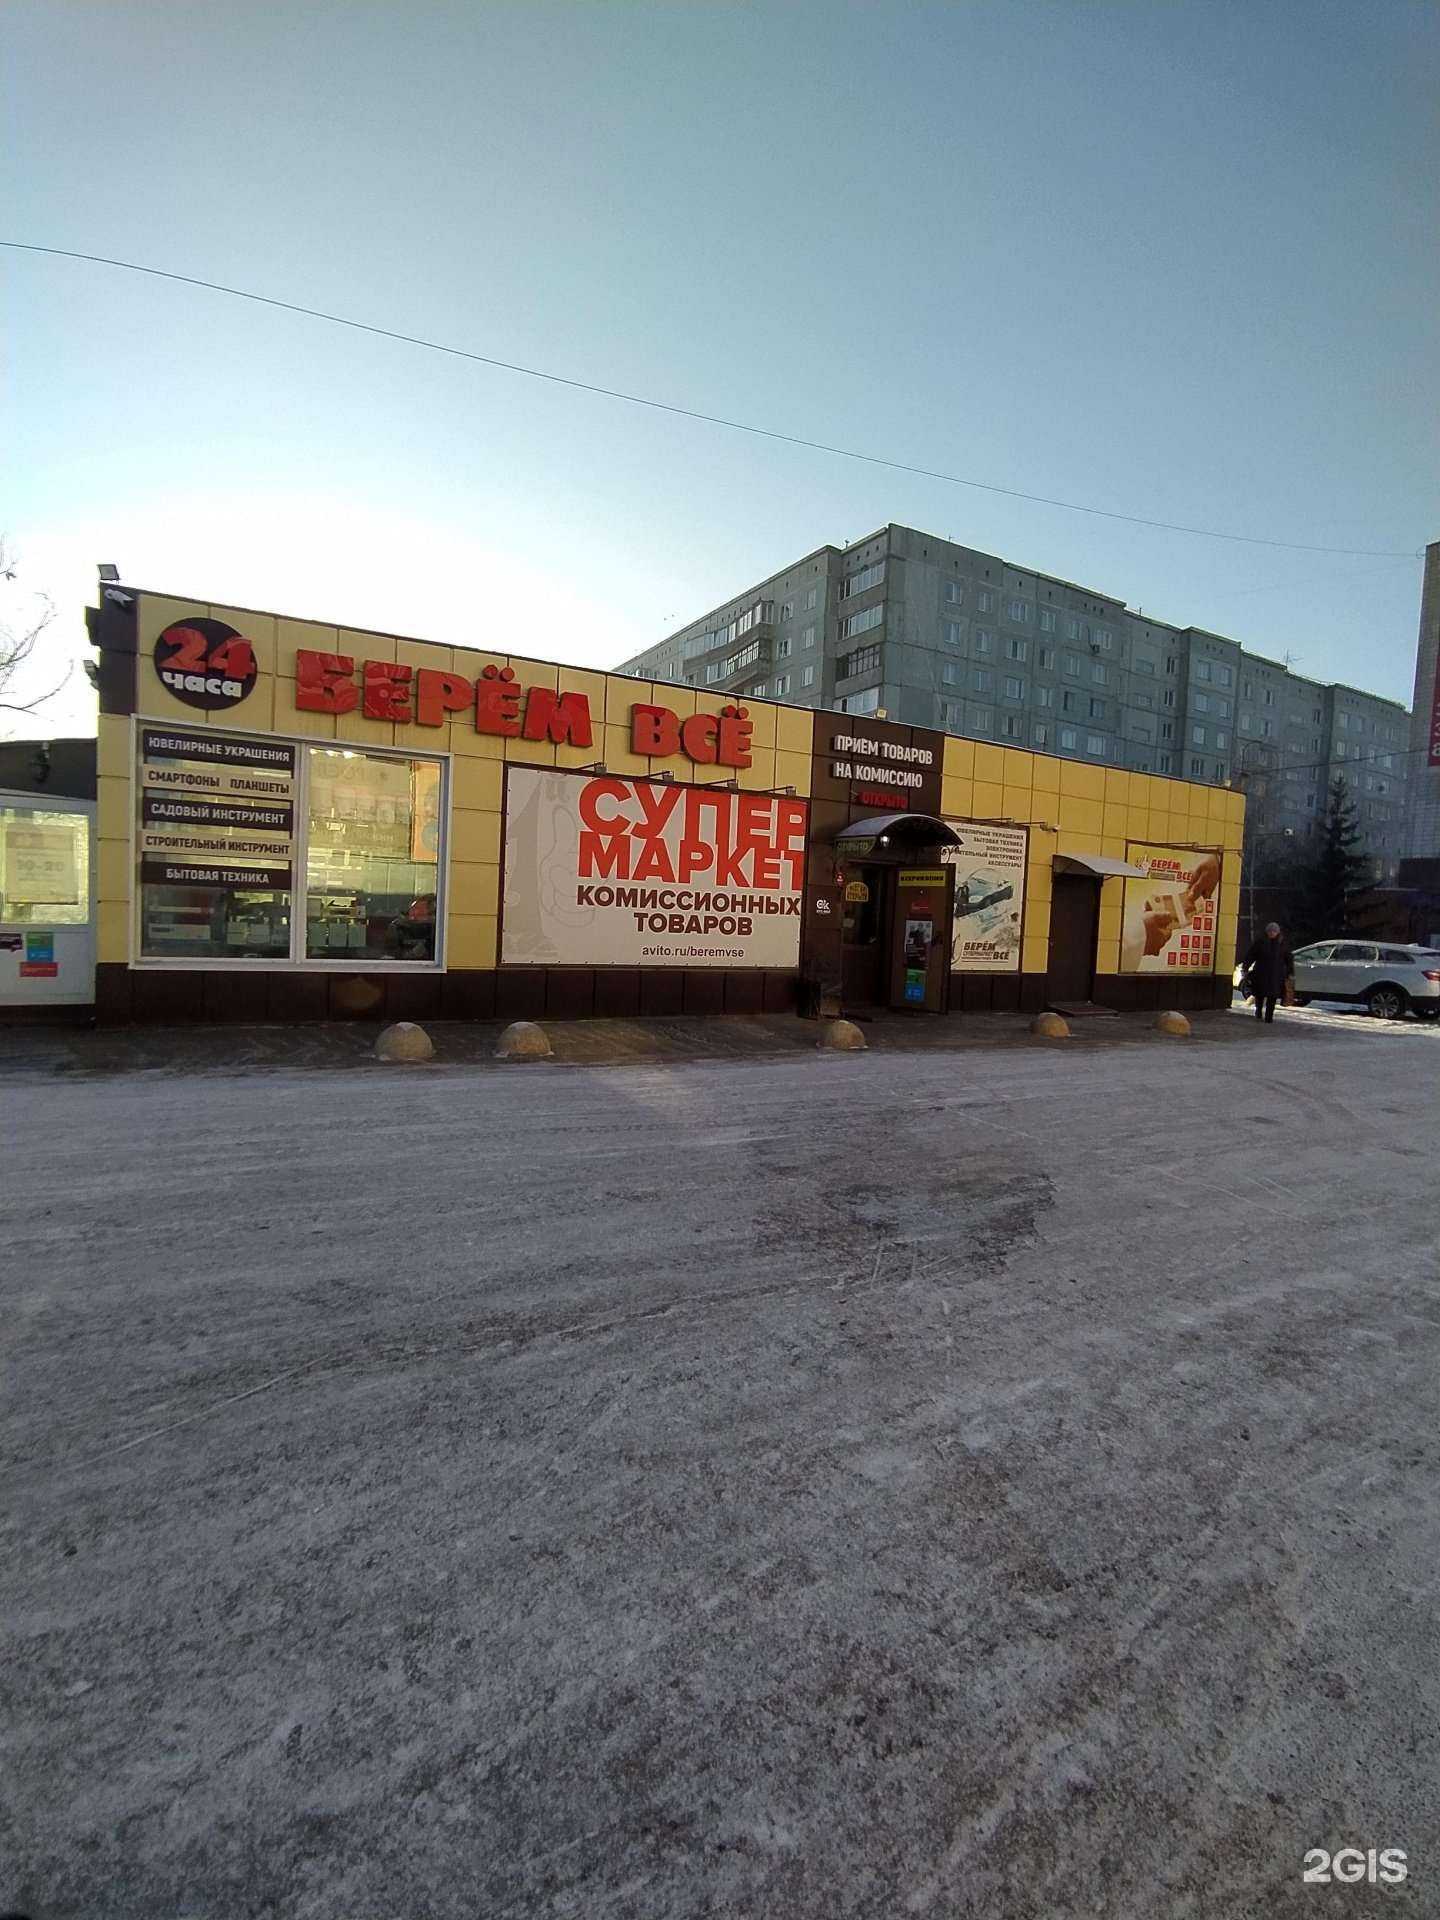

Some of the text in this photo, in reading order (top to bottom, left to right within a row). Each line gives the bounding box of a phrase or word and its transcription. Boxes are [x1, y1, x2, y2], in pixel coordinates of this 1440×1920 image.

[159, 626, 256, 680] 24
[162, 671, 243, 698] часа
[295, 648, 754, 770] БЕРЁМ ВСЁ
[148, 736, 290, 762] ЮВЕЛИРНЫЕ УКРАШЕНИЯ
[834, 734, 933, 765] ПРИЕМ ТОВАРОВ
[148, 770, 290, 794] СМАРТФОНЫ ПЛАНШЕТЫ
[833, 761, 923, 788] НА КОМИССИЮ
[151, 802, 286, 825] САДОВЫЙ ИНСТРУМЕНТ
[578, 777, 808, 851] СУПЕР
[145, 835, 290, 855] СТРОИТЕЛЬНЫЙ ИНСТРУМЕНТ
[577, 831, 805, 891] МАРКЕТ
[165, 867, 270, 884] БЫТОВАЯ ТЕХНИКА
[576, 884, 801, 916] КОМИССИОННЫХ
[633, 912, 753, 936] ТОВАРОВ
[642, 944, 745, 958] avito.ru/beremvse
